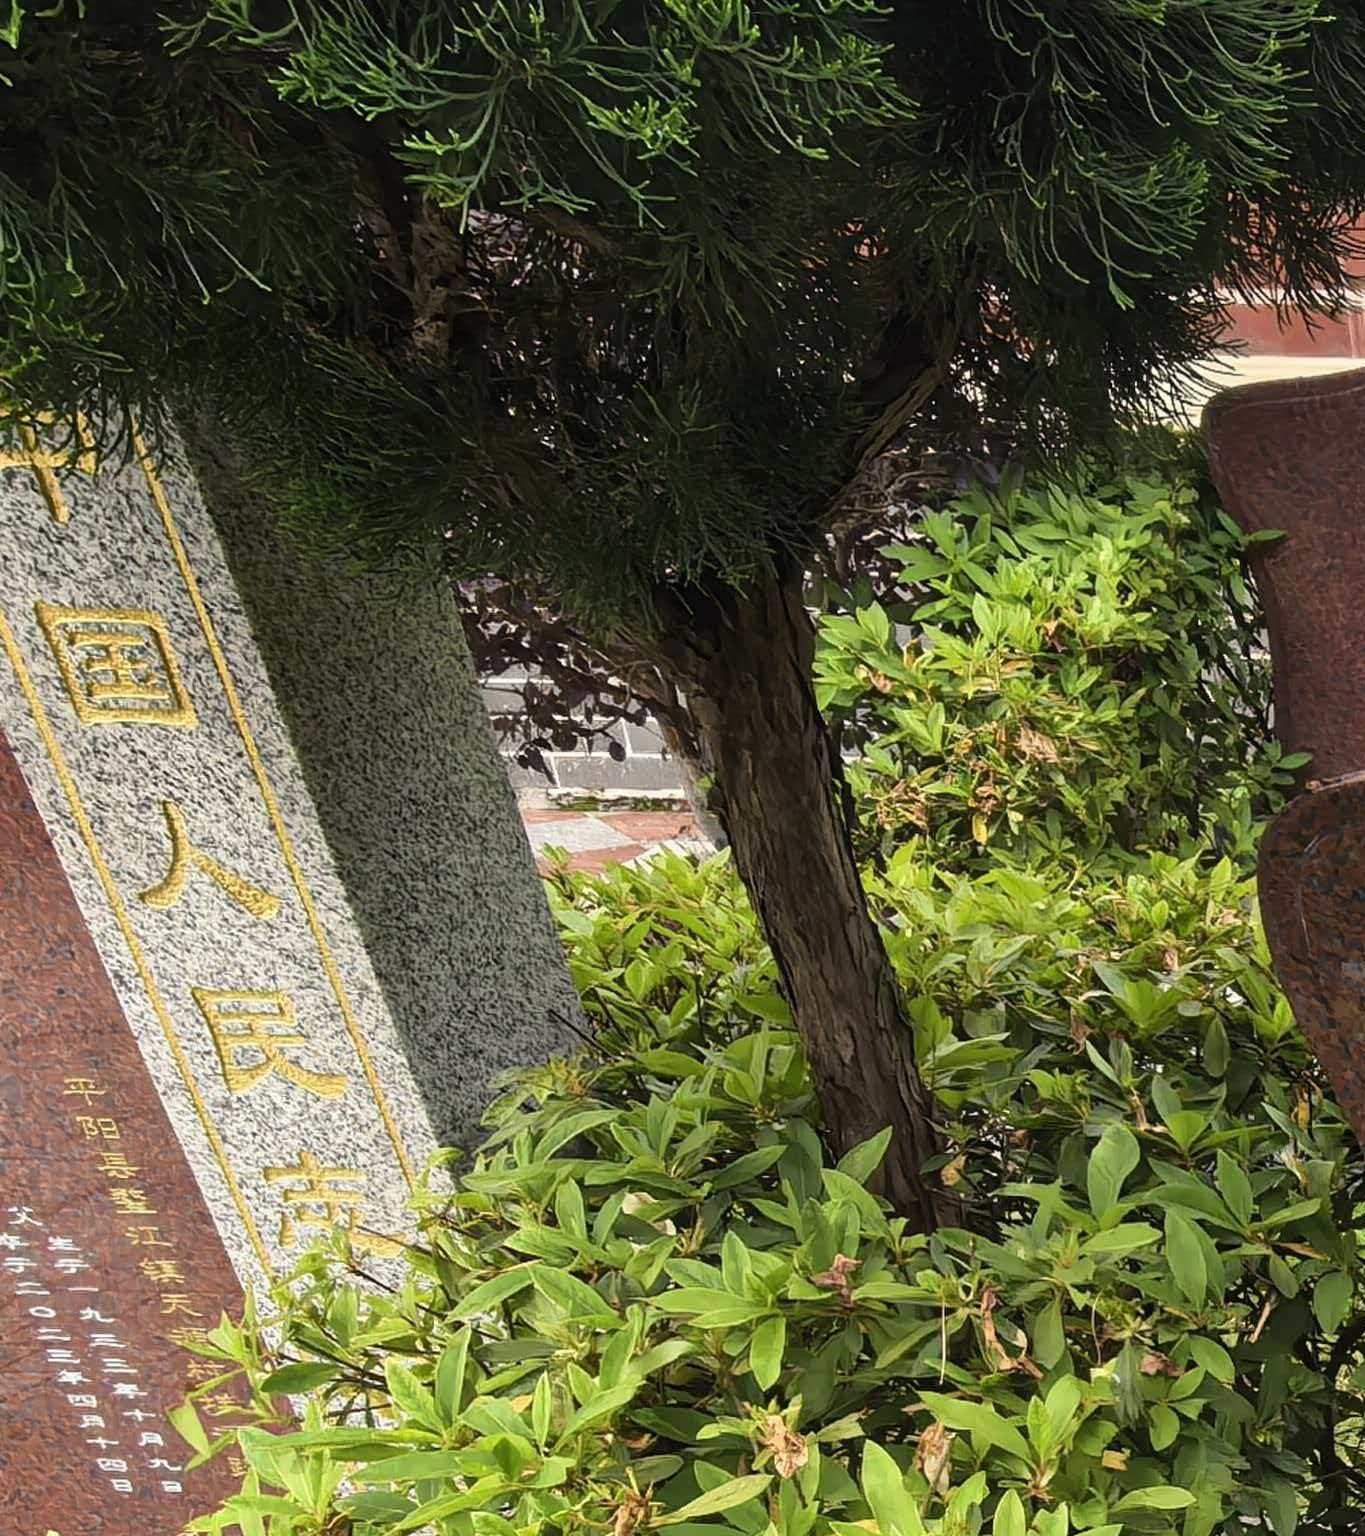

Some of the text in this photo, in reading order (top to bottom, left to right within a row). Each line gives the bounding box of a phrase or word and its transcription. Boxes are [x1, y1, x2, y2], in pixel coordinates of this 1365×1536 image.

[48, 1235, 182, 1493] 生于一九三三年十月九日
